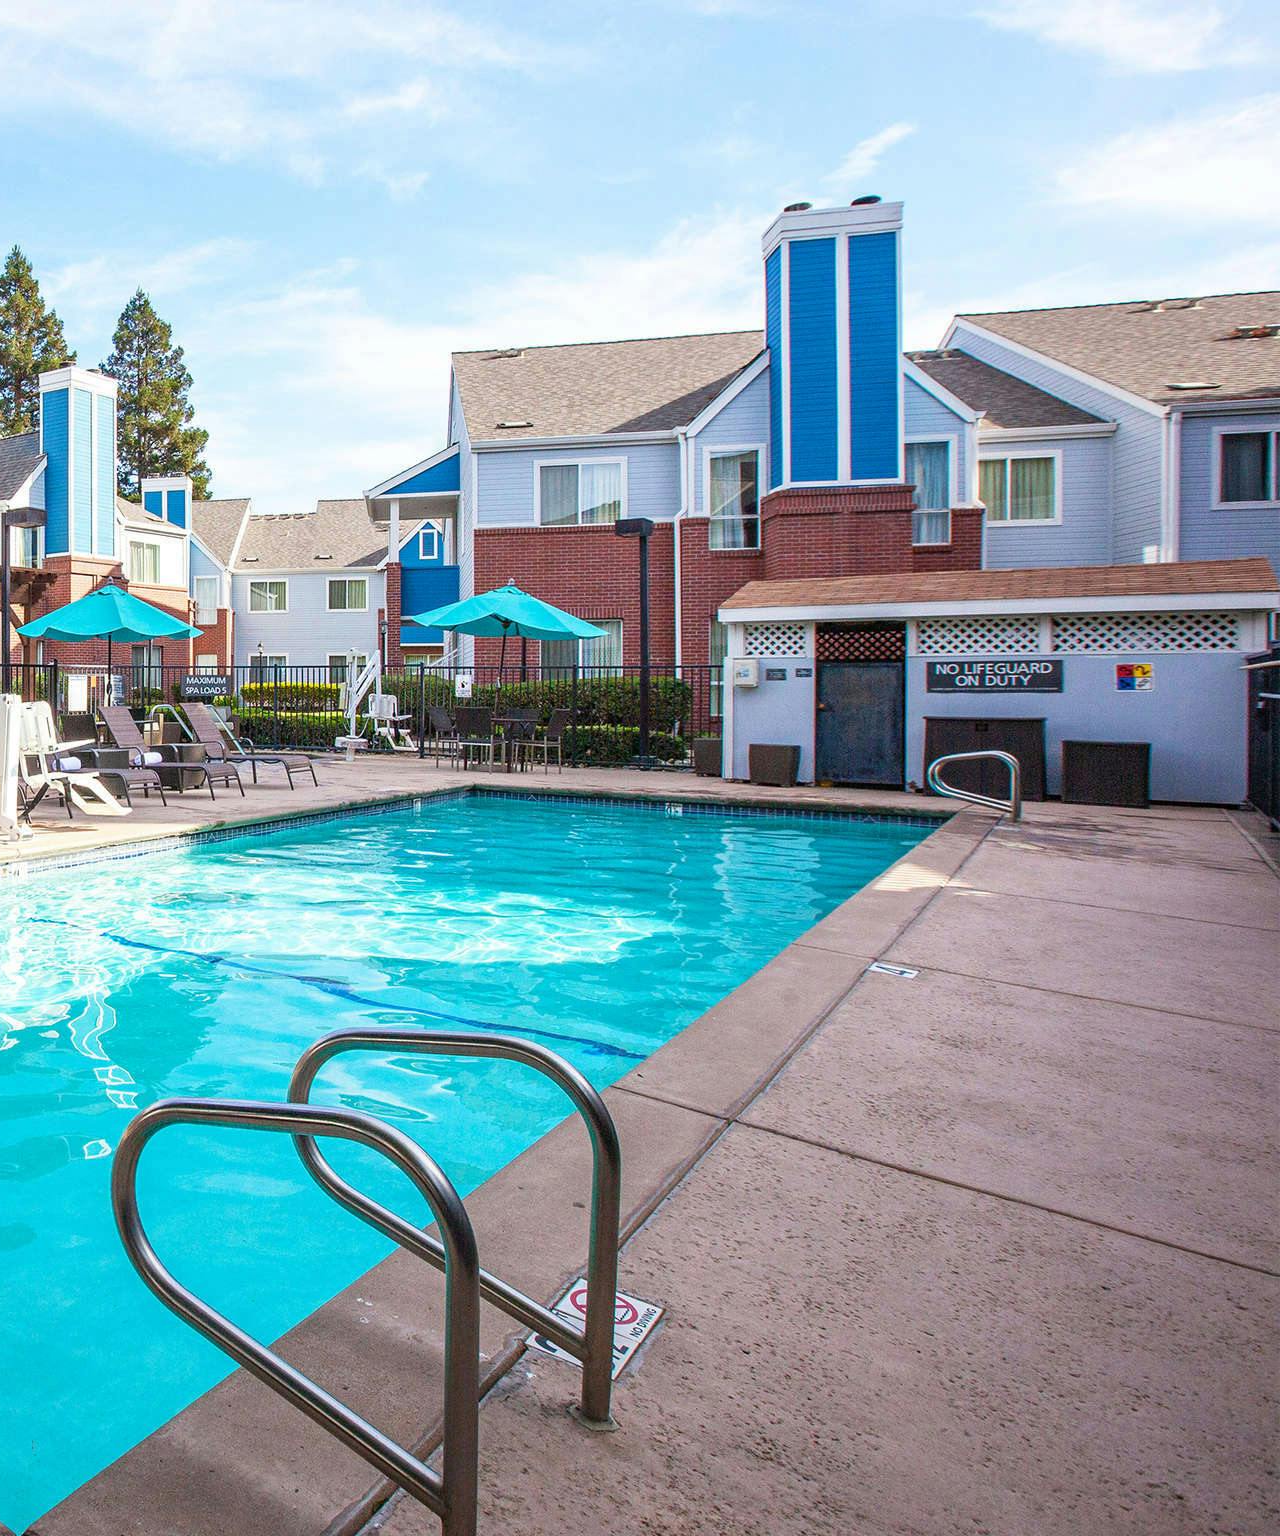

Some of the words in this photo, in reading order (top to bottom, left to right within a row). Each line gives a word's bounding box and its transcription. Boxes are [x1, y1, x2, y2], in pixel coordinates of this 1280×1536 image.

[935, 663, 959, 675] NO
[964, 662, 1053, 675] LIFEGUARD
[186, 676, 226, 685] MAXIMUM
[955, 675, 979, 686] ON
[985, 674, 1032, 686] DUTY
[185, 686, 200, 695] SPA
[200, 686, 221, 695] LOAD
[222, 686, 227, 694] 5
[636, 1307, 657, 1328] DIVING
[630, 1326, 643, 1339] NO
